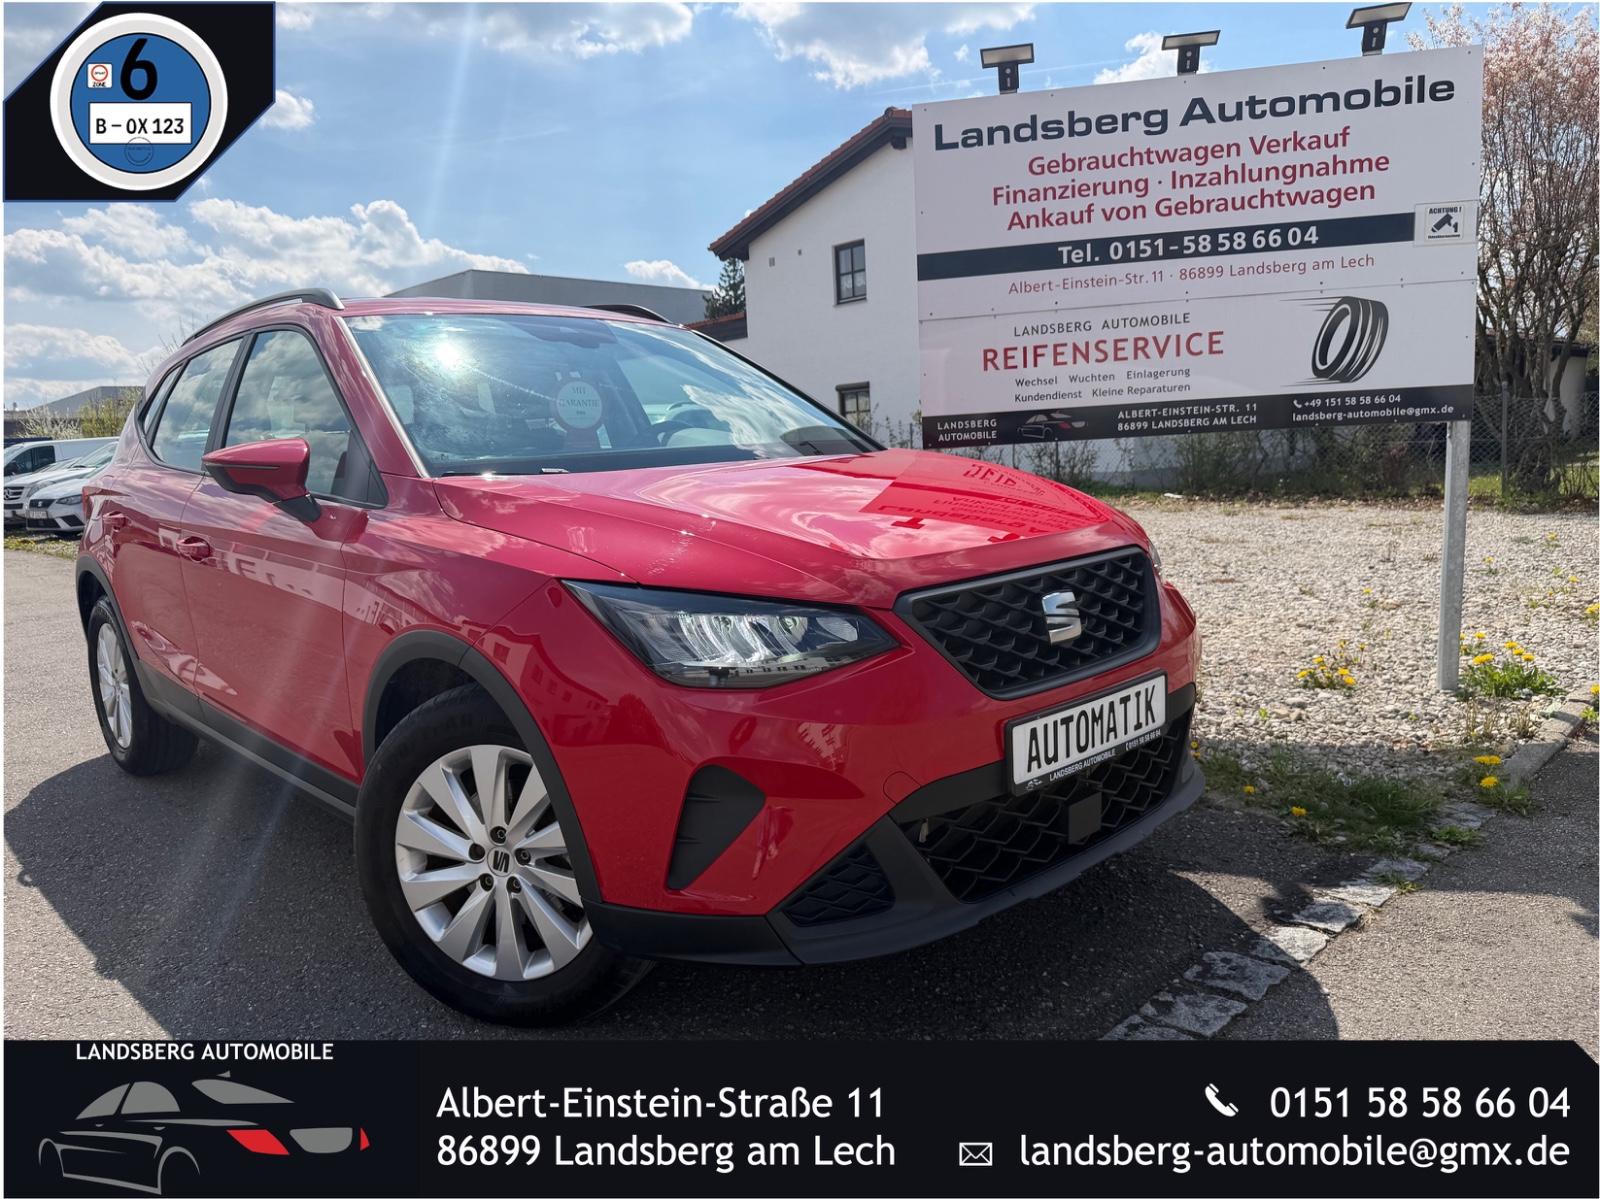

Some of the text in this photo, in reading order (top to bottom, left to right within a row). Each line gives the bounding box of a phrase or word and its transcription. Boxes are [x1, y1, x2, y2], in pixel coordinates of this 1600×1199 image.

[934, 75, 1455, 151] Landsberg Automobile
[1028, 125, 1350, 176] Gebrauchtwagen Verkauf
[992, 154, 1390, 206] Finanzierung Inzahlungnahme
[1007, 184, 1376, 231] Ankauf von Gebrauchtwagen
[1429, 206, 1458, 214] ACHTUNG
[1058, 225, 1319, 264] Tel. 0151-58 58 66 04
[1179, 265, 1224, 281] 86899
[1229, 259, 1307, 277] Landsberg
[1312, 259, 1335, 271] am
[1340, 253, 1375, 269] Lech
[1014, 312, 1191, 337] LANDSBERG AUTOMOBILE
[983, 331, 1224, 371] REIFENSERVICE
[1015, 366, 1191, 388] Wechsel Wuchten Einlagerung
[1014, 383, 1191, 403] Kundendienst Kleine Reparaturen
[1304, 394, 1401, 408] +49 151 58 58 66 04
[1117, 403, 1258, 418] ALBERT-EINSTEIN-STR. 11
[1117, 415, 1257, 431] 86899 LANDSBERG AM LECH
[1292, 405, 1454, 422] landsberg-automobile@gmx.de
[937, 419, 997, 430] LANDSBERG
[938, 430, 997, 442] AUTOMOBILE
[1027, 685, 1156, 773] AUTOMATIK
[1049, 761, 1083, 781] LANDSBERG
[1083, 748, 1117, 767] AUTOMOBILE
